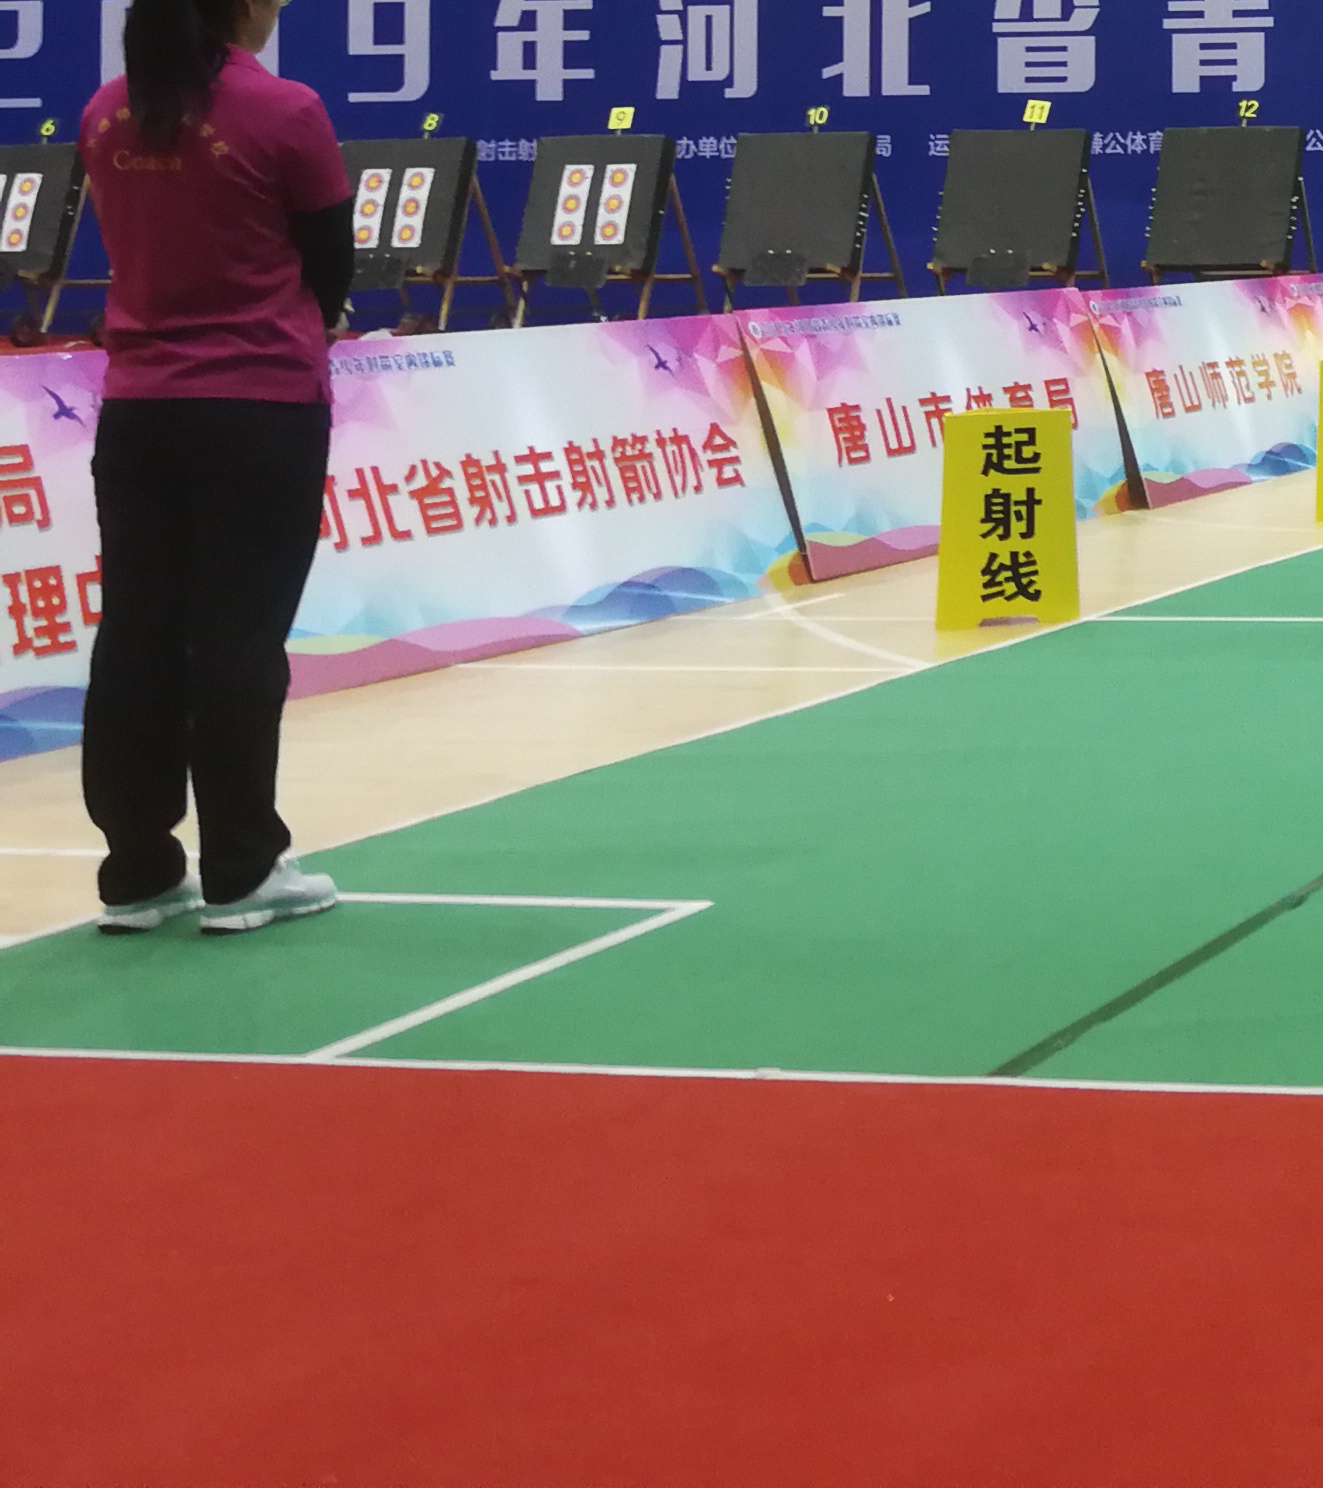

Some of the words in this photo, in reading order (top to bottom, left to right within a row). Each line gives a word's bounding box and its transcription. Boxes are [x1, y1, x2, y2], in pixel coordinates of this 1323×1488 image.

[808, 107, 829, 125] 10
[1029, 104, 1046, 120] 11
[1238, 99, 1259, 117] 12
[425, 113, 439, 131] 8
[616, 110, 627, 125] 9
[40, 118, 56, 136] 6
[1146, 348, 1302, 421] 唐山师范学院
[979, 423, 1044, 605] 起射线
